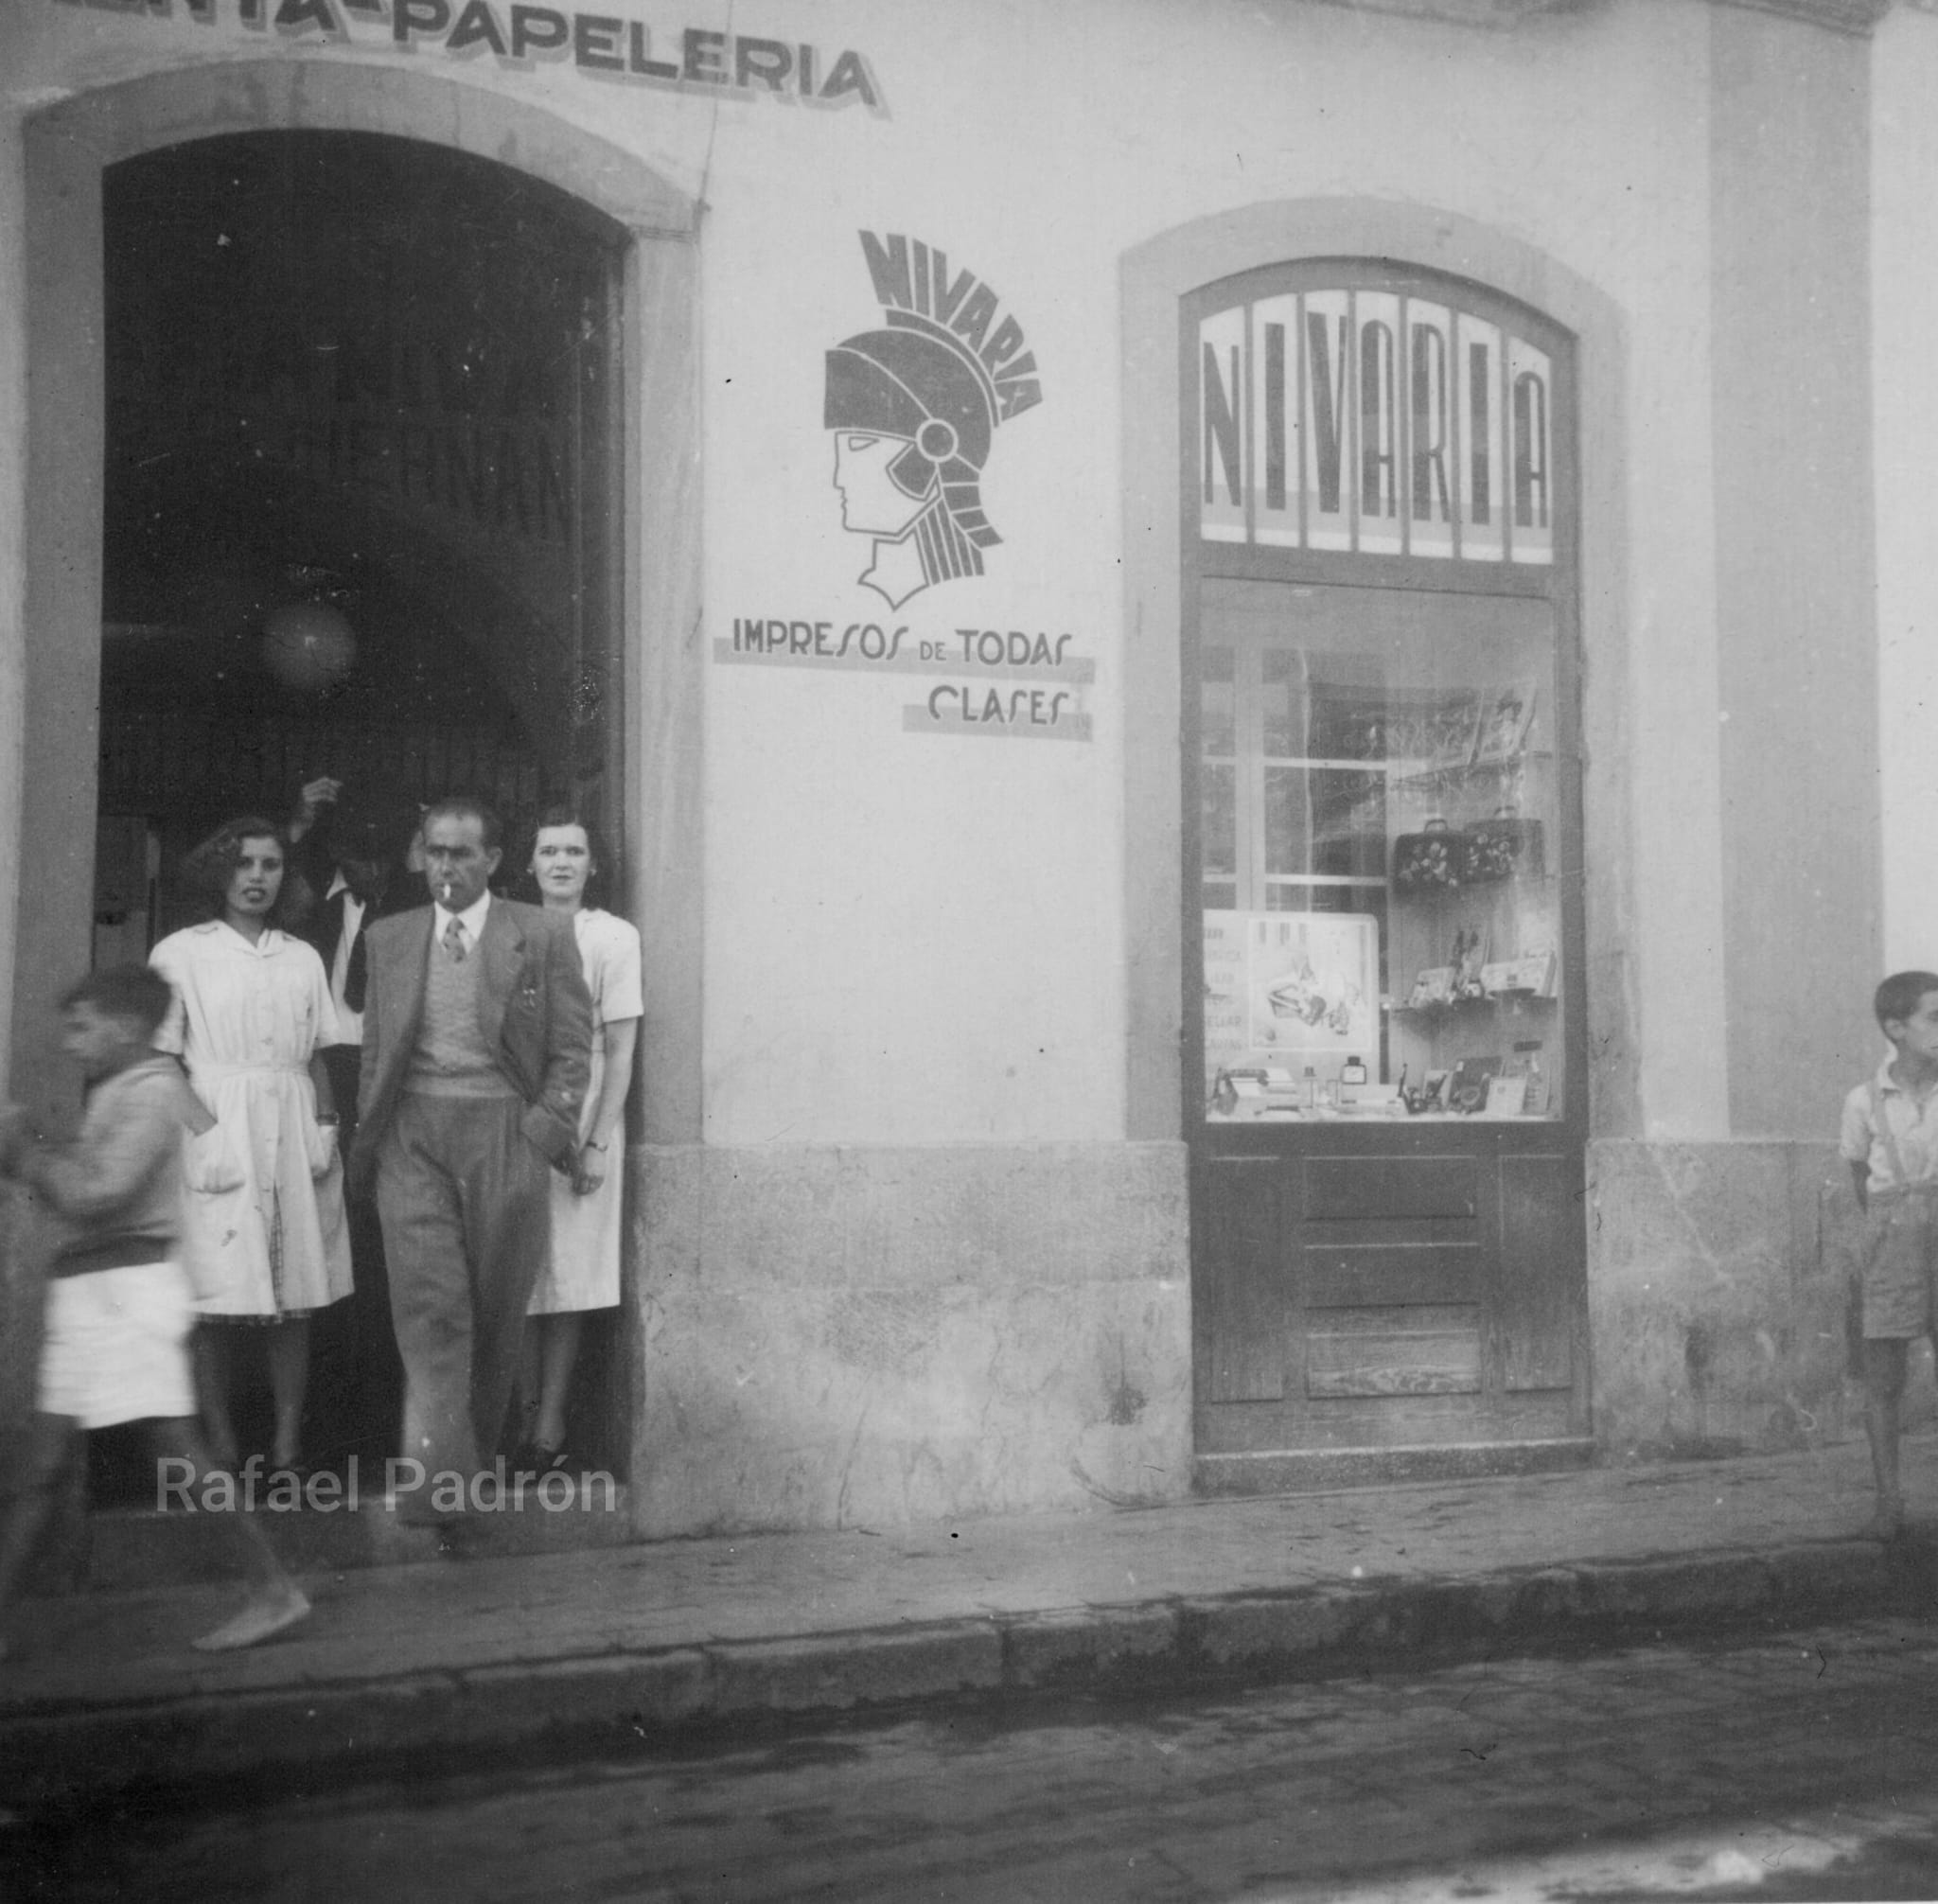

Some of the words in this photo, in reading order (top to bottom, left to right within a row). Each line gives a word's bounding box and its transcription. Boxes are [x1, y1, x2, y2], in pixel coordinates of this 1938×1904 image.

[857, 229, 1043, 422] NIVARIA
[1203, 310, 1548, 529] NIVARIA
[732, 618, 908, 661] IMPRESOS
[919, 641, 946, 661] DE
[955, 628, 1072, 666] TODAS
[927, 685, 1069, 725] CLASES
